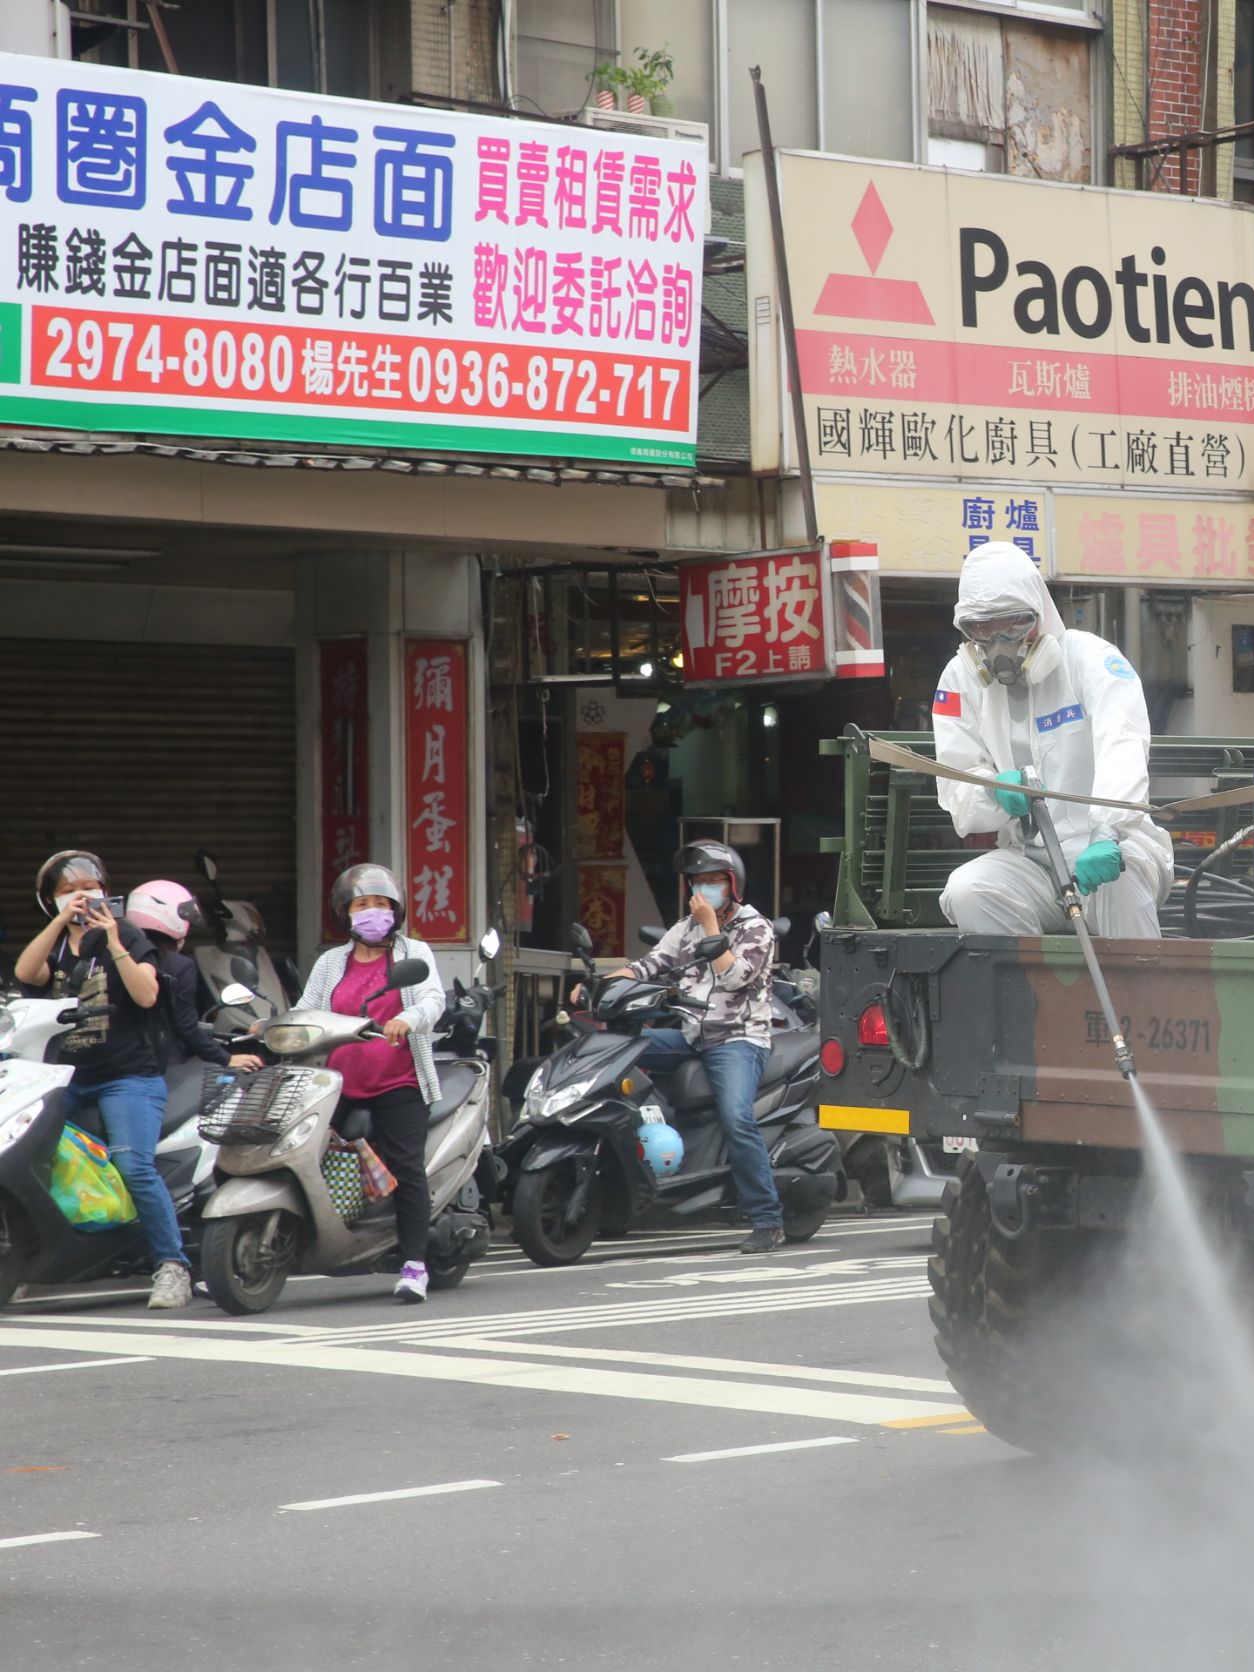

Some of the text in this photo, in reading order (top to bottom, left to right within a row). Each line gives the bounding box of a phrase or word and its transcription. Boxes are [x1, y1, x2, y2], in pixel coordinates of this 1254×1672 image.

[474, 136, 697, 244] 買賣租賃需求
[16, 222, 454, 327] 賺錢金店面適各行百業
[472, 242, 694, 348] 歡迎委託洽詢
[45, 316, 681, 421] 2974-8080 楊先生 0936-872-717
[828, 345, 918, 390] 熱水器
[1007, 360, 1091, 402] 瓦斯爐
[411, 656, 457, 923] 彌月蛋糕
